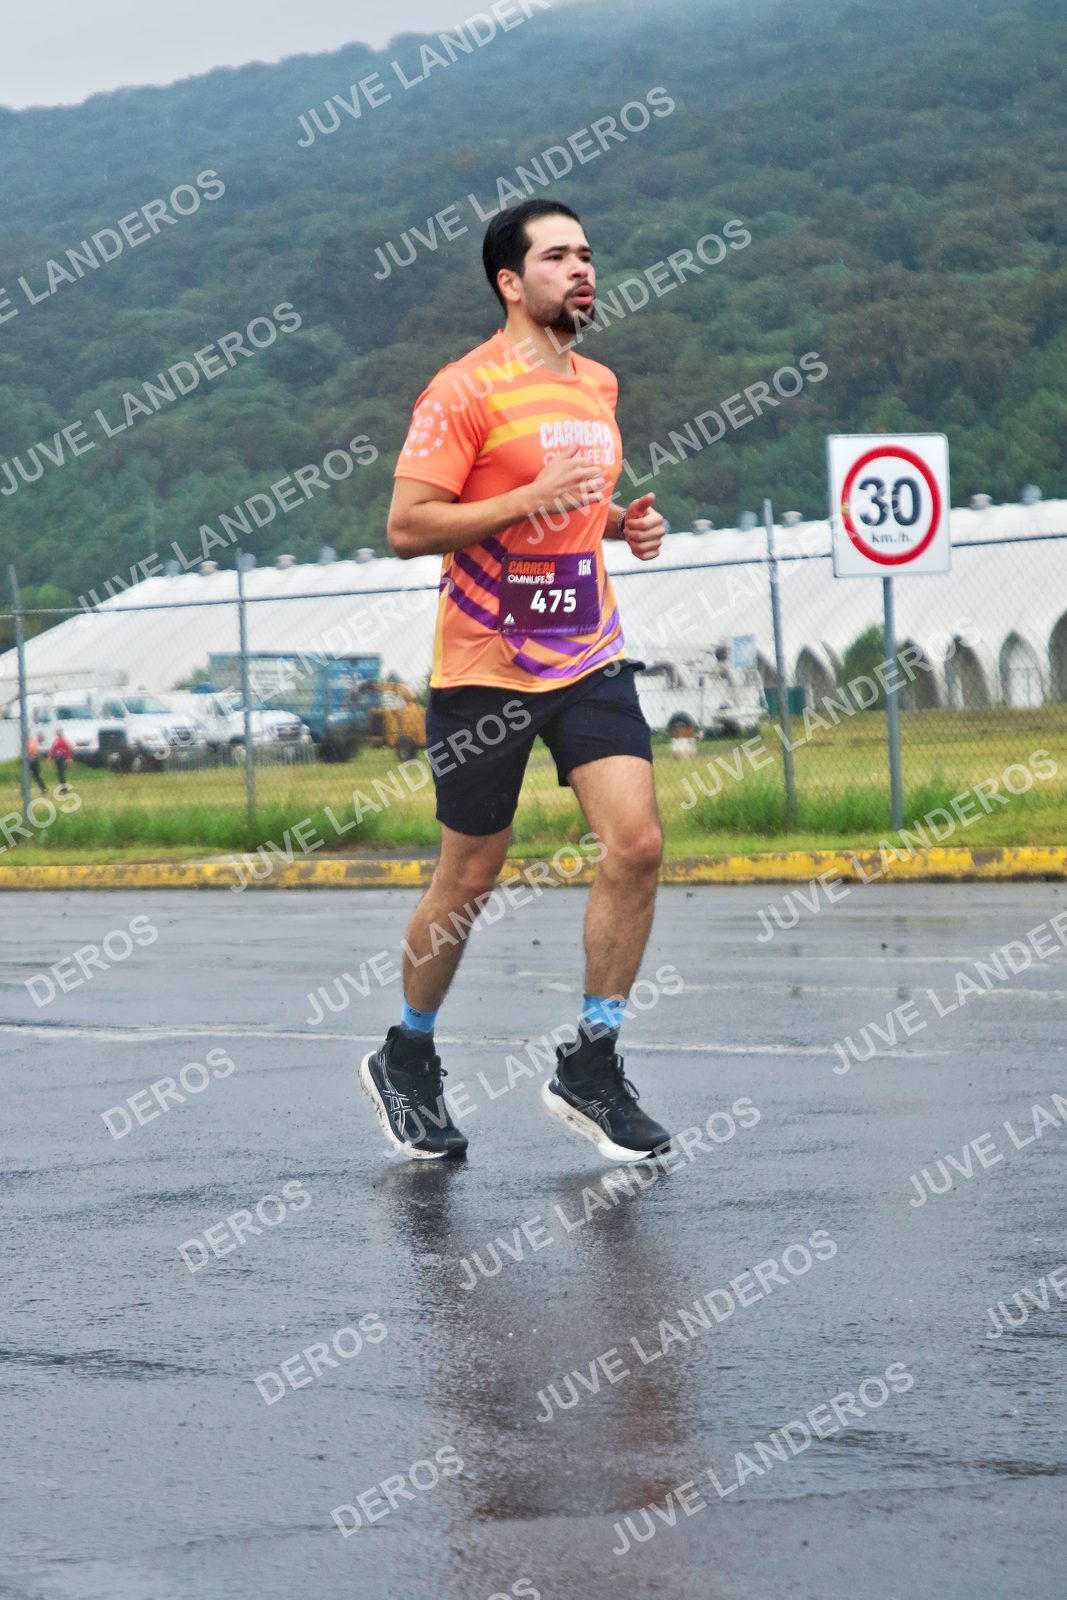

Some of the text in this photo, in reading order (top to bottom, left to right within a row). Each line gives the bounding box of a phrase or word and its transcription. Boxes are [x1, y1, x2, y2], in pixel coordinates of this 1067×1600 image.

[541, 420, 614, 449] CARRERA
[858, 476, 921, 526] 30
[508, 560, 556, 574] CARRERA
[530, 588, 577, 613] 475
